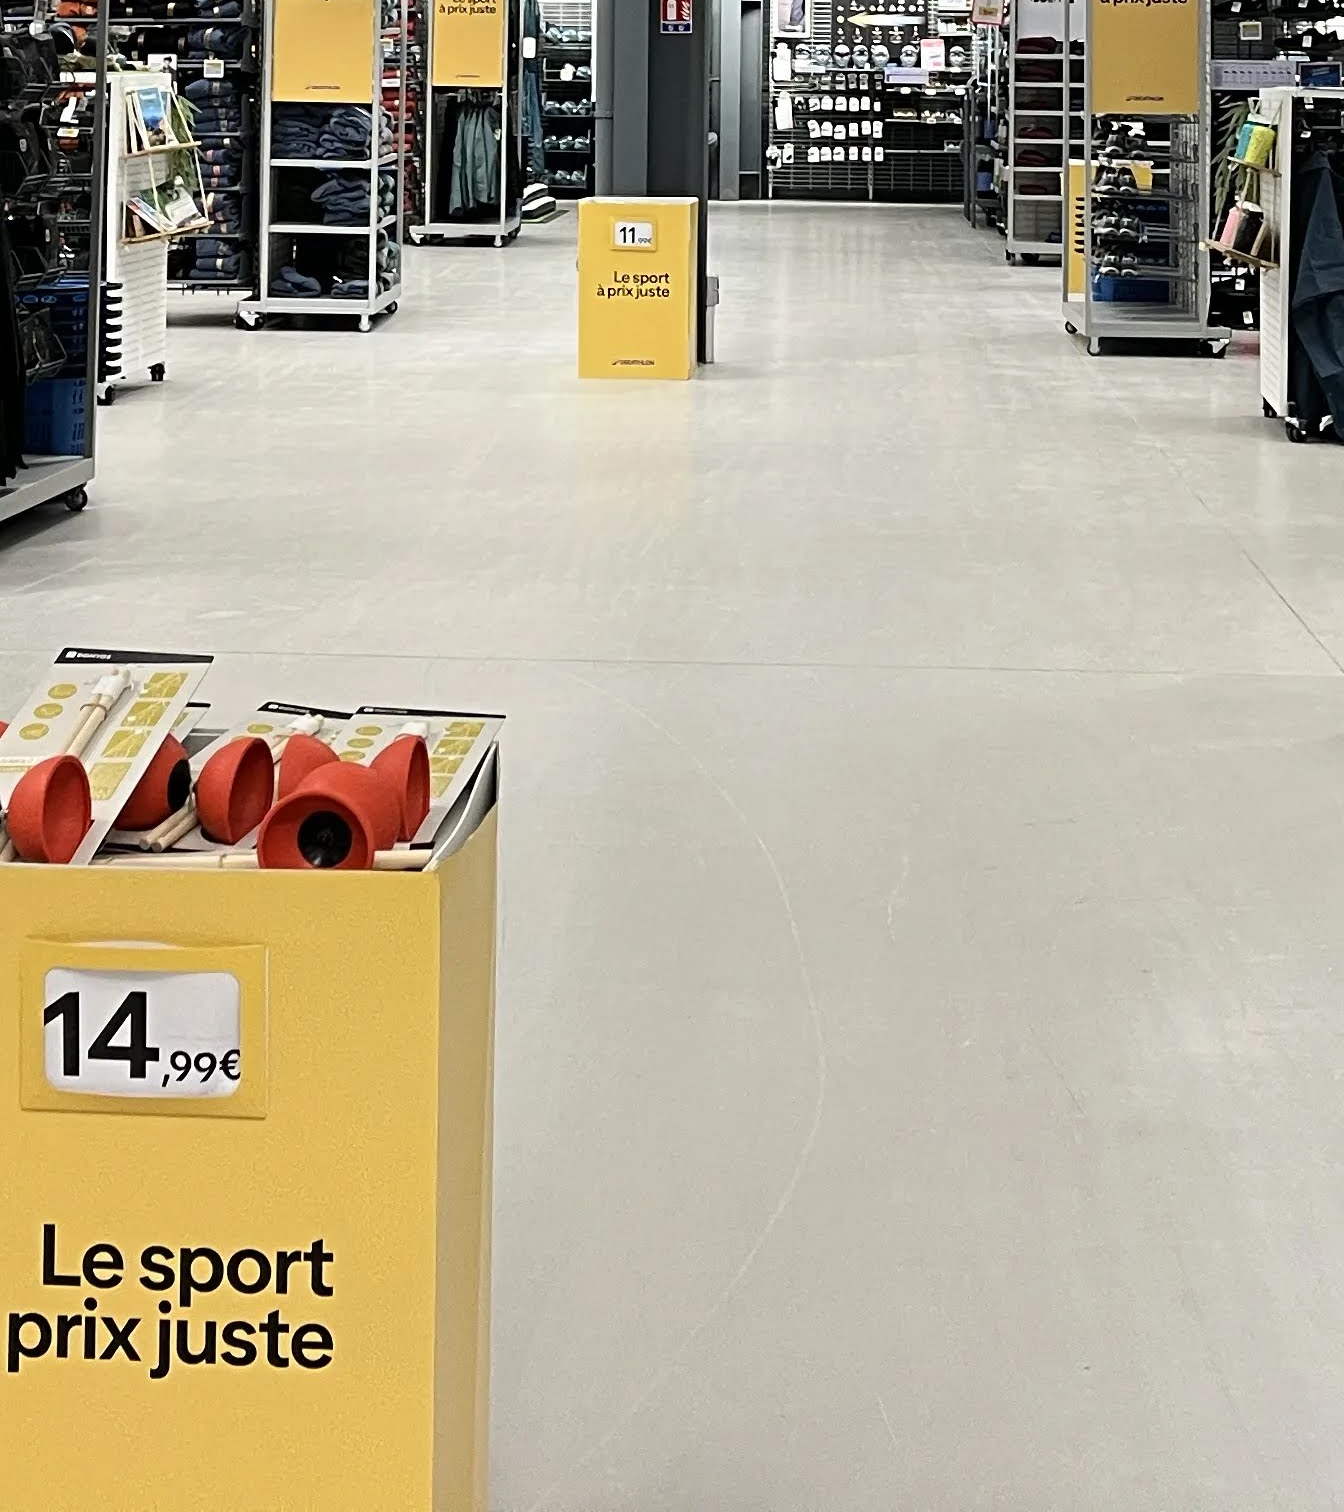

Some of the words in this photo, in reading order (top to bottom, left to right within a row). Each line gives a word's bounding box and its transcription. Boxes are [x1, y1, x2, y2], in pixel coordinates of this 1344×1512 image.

[439, 3, 446, 13] à
[447, 4, 468, 15] prix
[468, 4, 497, 15] juste
[613, 271, 631, 284] Le
[632, 272, 670, 286] sport
[596, 284, 605, 297] à
[607, 284, 634, 299] prix
[634, 284, 670, 300] juste
[42, 1223, 124, 1288] Le
[139, 1238, 334, 1307] sport
[7, 1298, 142, 1373] prix
[149, 1299, 334, 1380] juste
